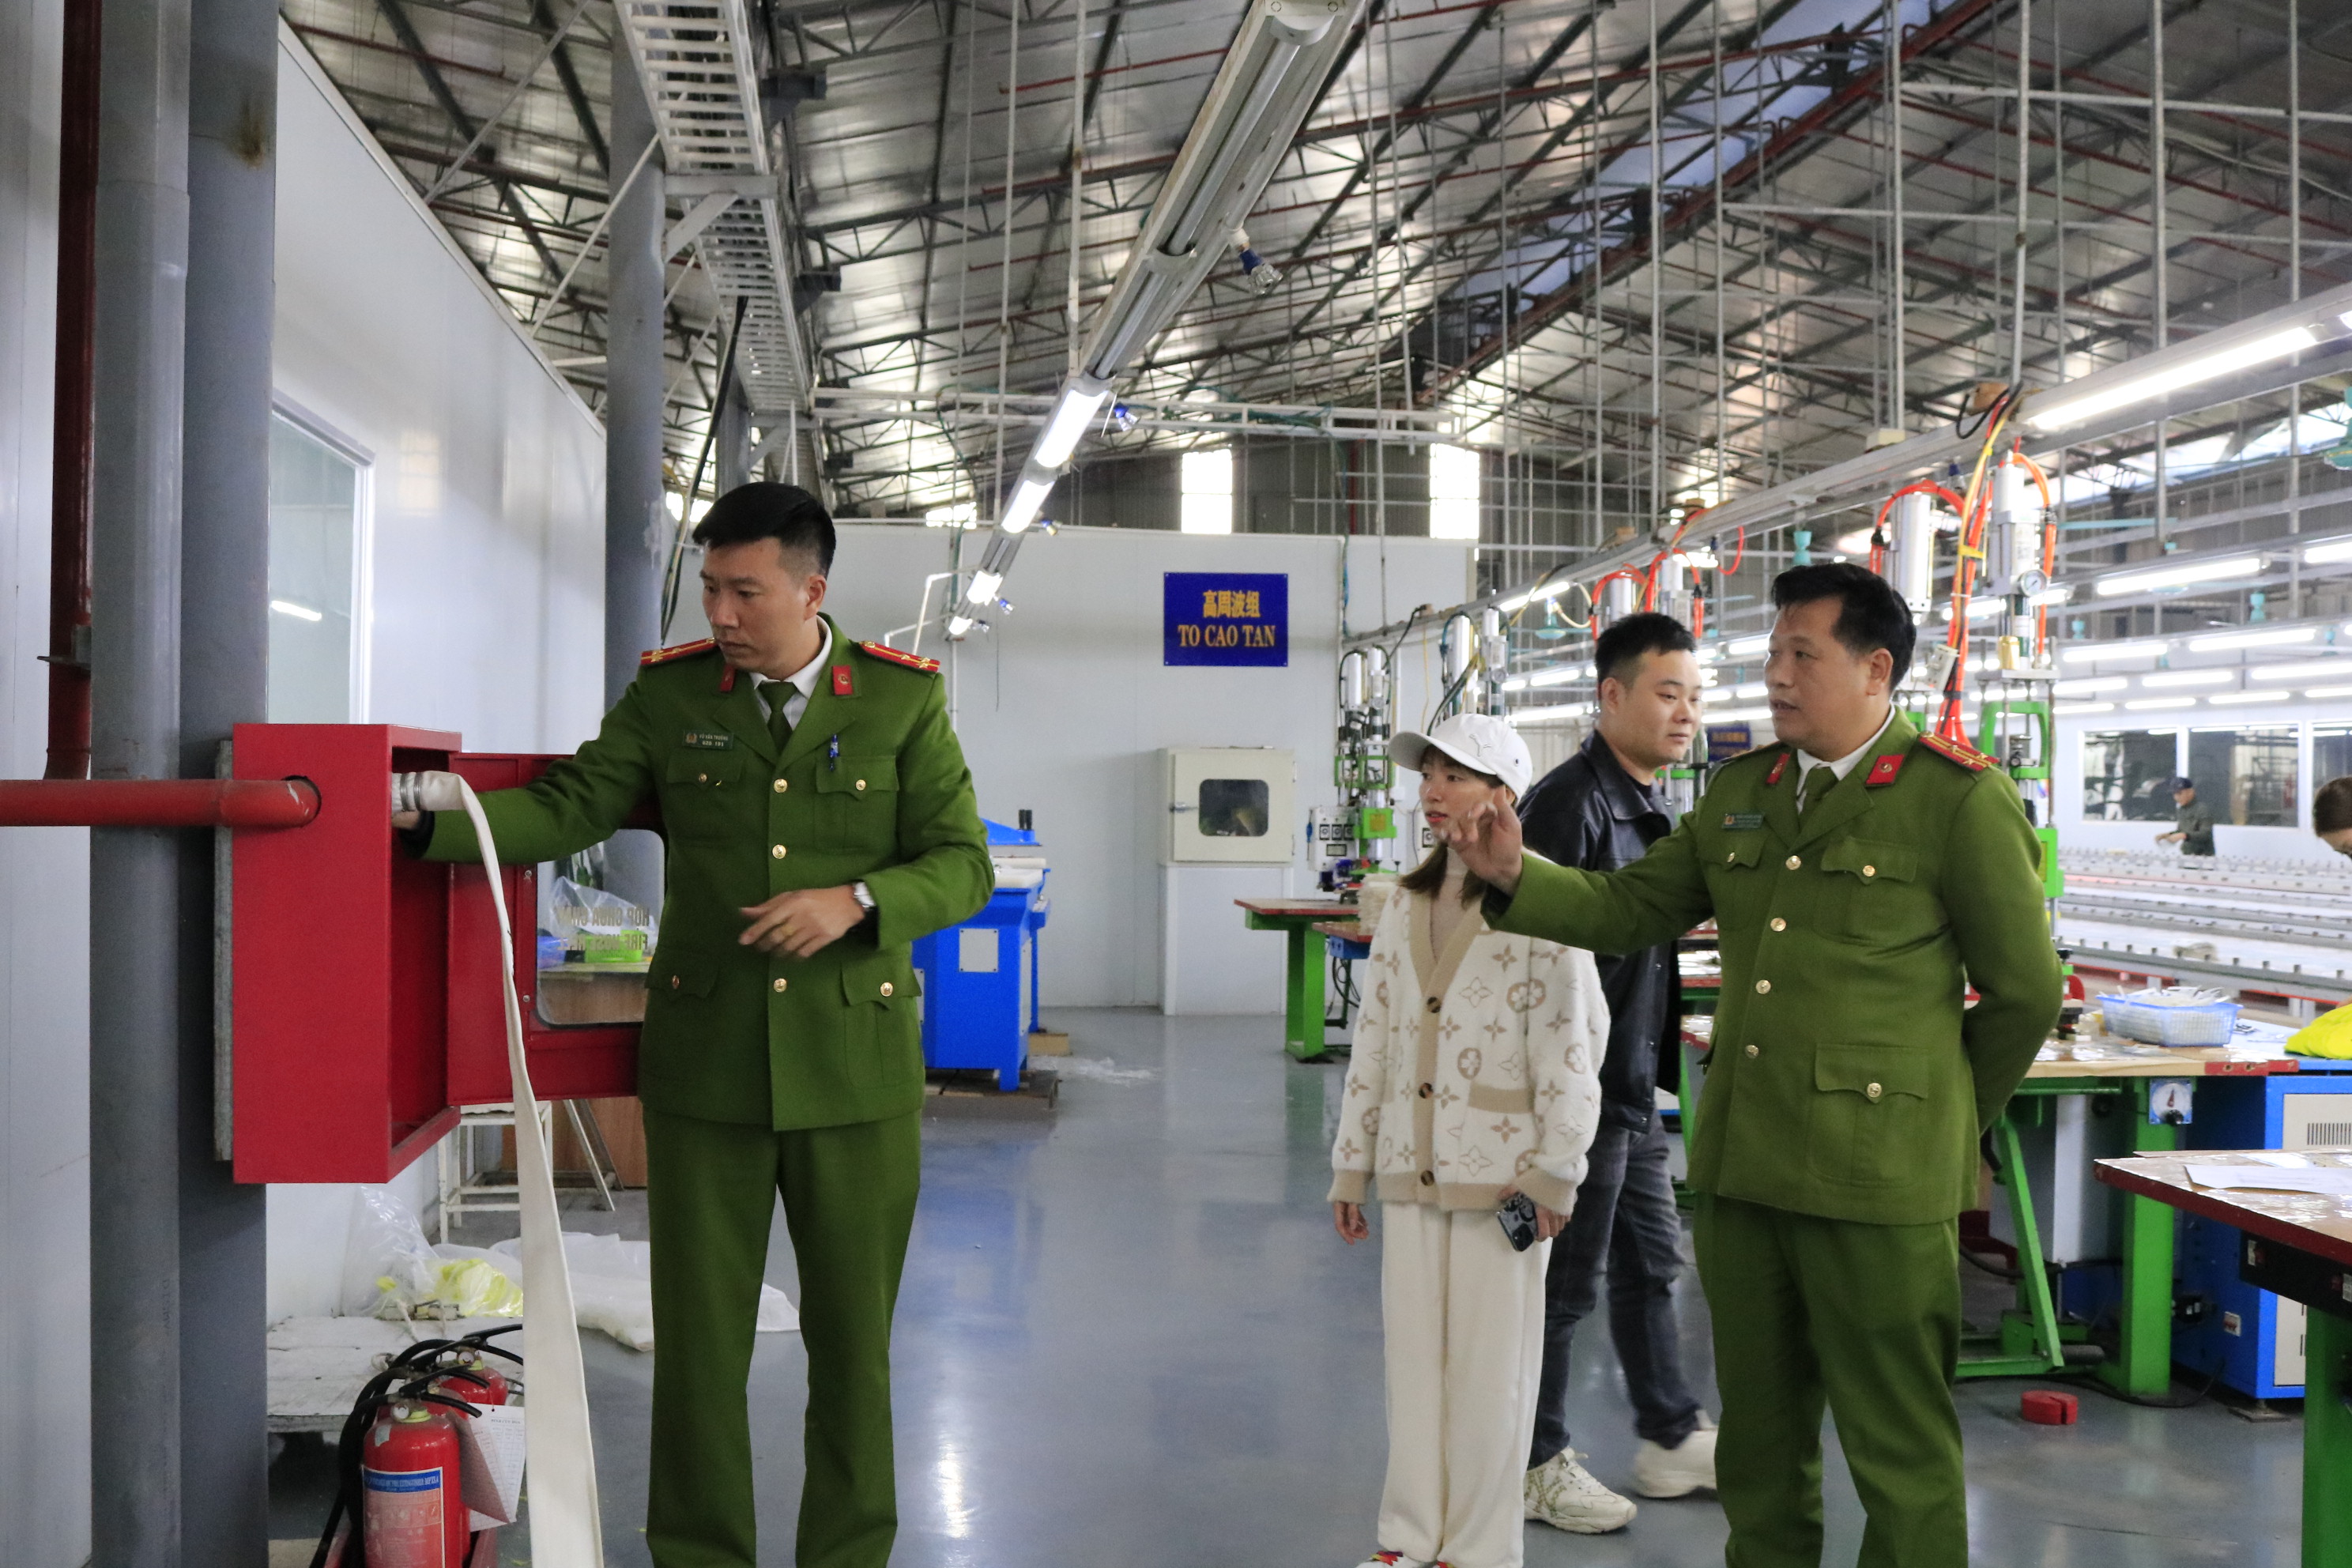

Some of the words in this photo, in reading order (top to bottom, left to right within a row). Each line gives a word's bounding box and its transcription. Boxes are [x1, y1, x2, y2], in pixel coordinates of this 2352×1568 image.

[1203, 590, 1261, 618] 高周波组
[1178, 624, 1200, 647] TO
[1204, 624, 1238, 647] CAO
[1242, 625, 1276, 648] TAN
